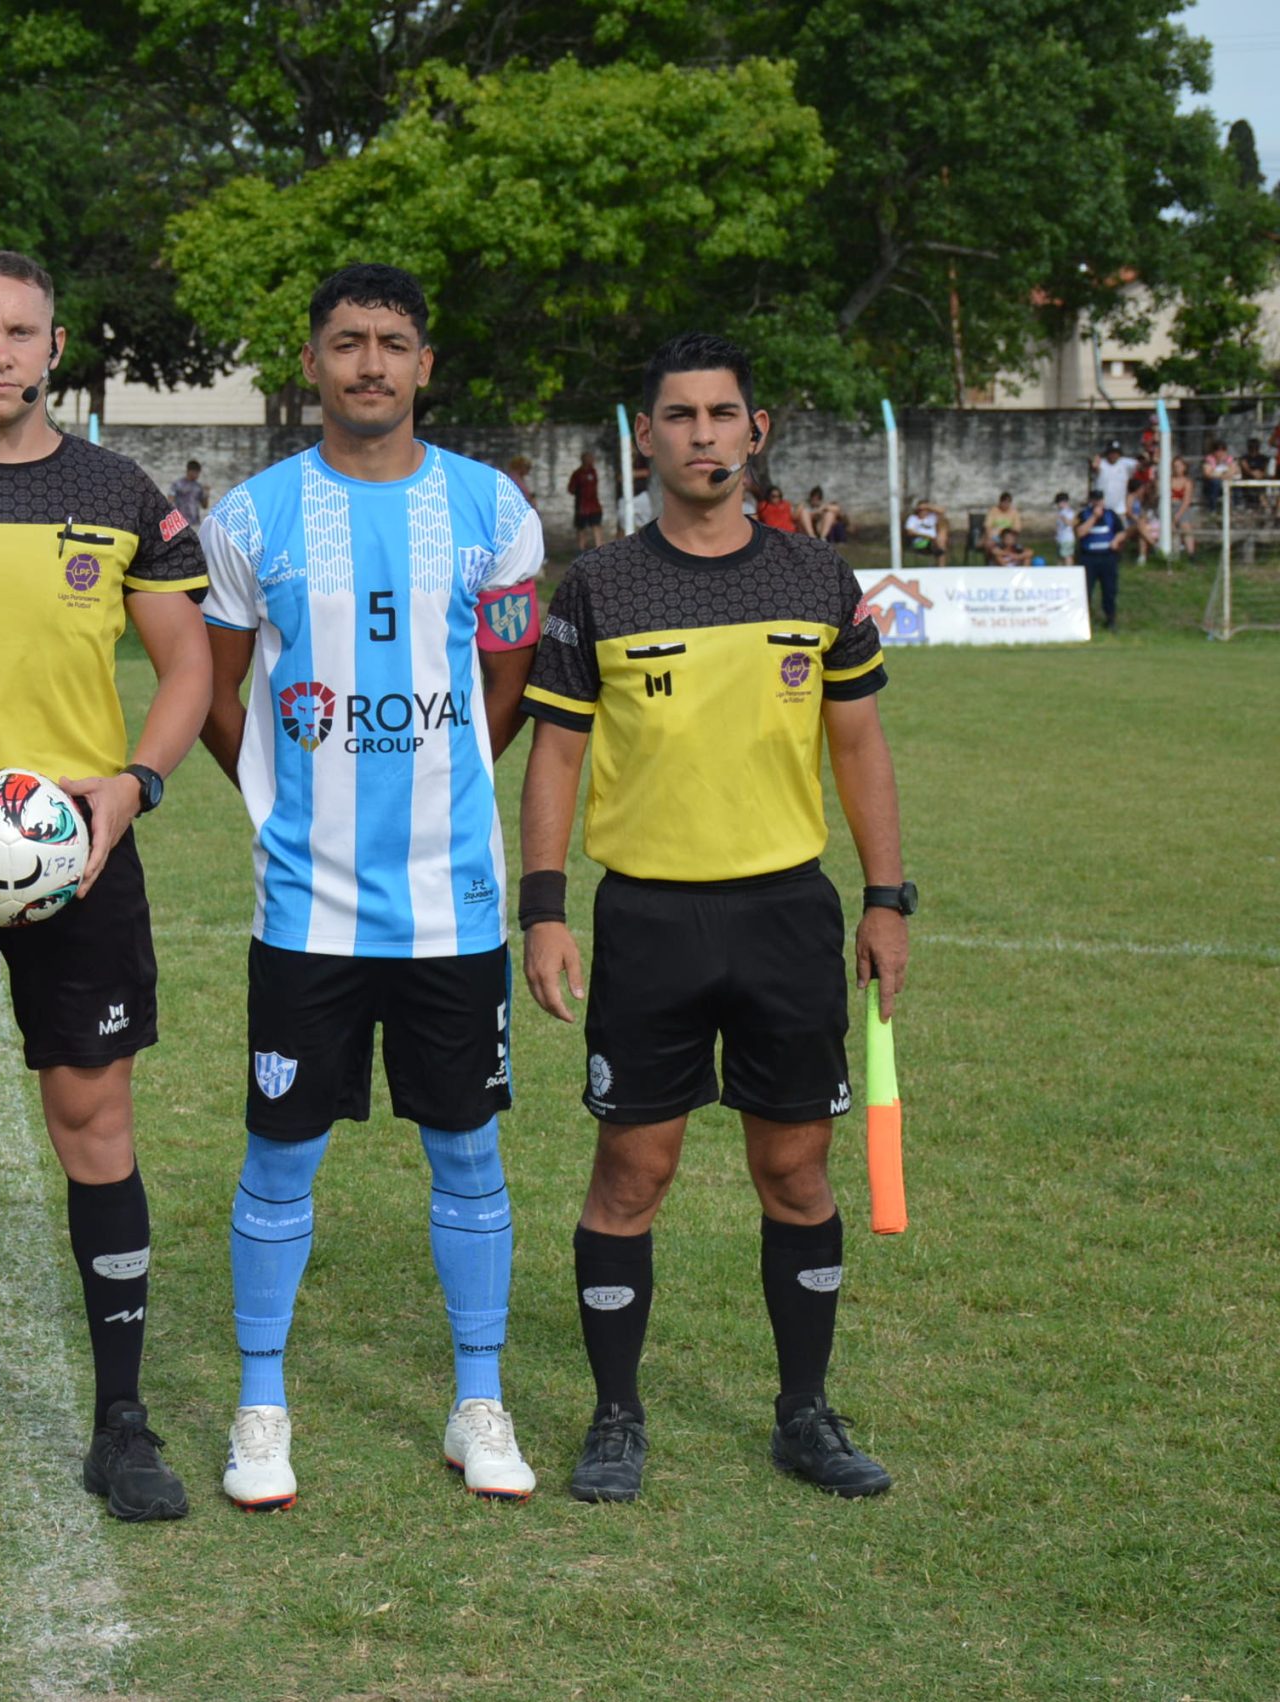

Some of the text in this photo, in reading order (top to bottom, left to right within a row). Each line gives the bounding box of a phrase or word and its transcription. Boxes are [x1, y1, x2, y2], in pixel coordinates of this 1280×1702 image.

[74, 568, 90, 577] LPF
[944, 588, 1010, 602] VALDEZ
[369, 591, 396, 642] 5
[346, 690, 470, 733] ROYAL
[344, 737, 425, 754] GROUP
[99, 1016, 130, 1036] Meta
[816, 1274, 838, 1284] LPF
[596, 1294, 619, 1302] LPF
